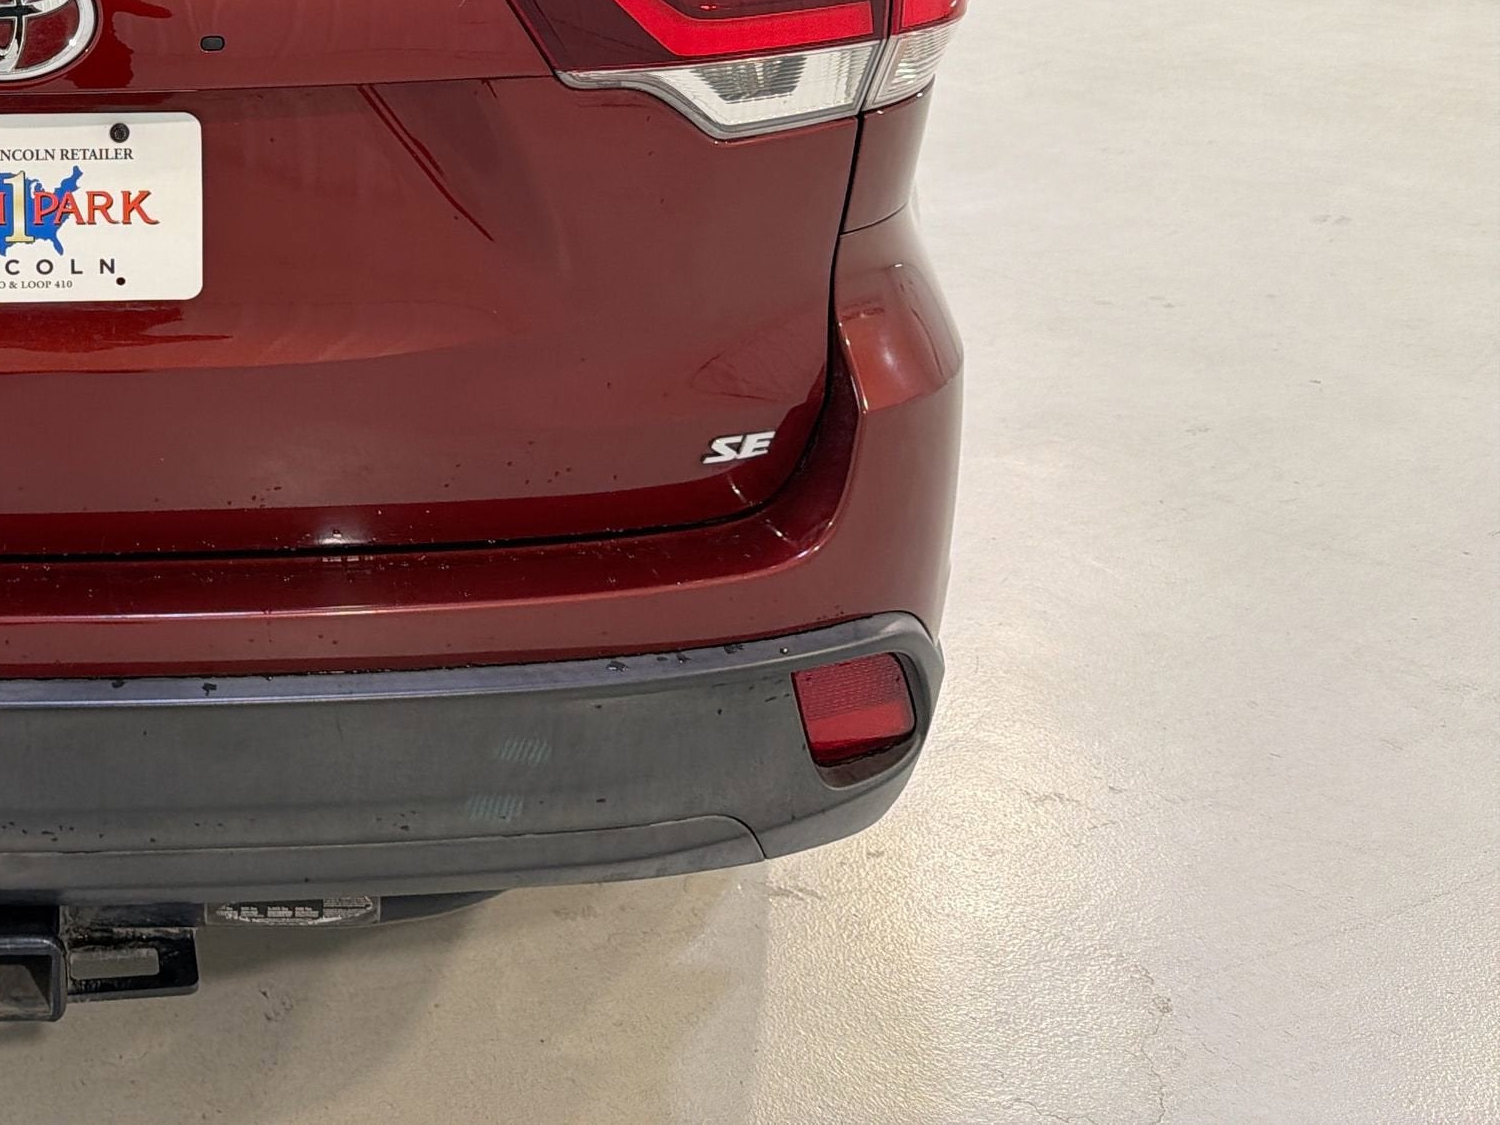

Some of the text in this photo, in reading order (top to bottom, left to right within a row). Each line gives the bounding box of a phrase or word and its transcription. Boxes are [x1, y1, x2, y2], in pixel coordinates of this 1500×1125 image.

[60, 147, 134, 161] RETAILER
[32, 190, 160, 226] PARK
[8, 280, 18, 289] &
[21, 280, 52, 289] LOOP
[54, 279, 73, 289] 410
[701, 430, 777, 465] SE
